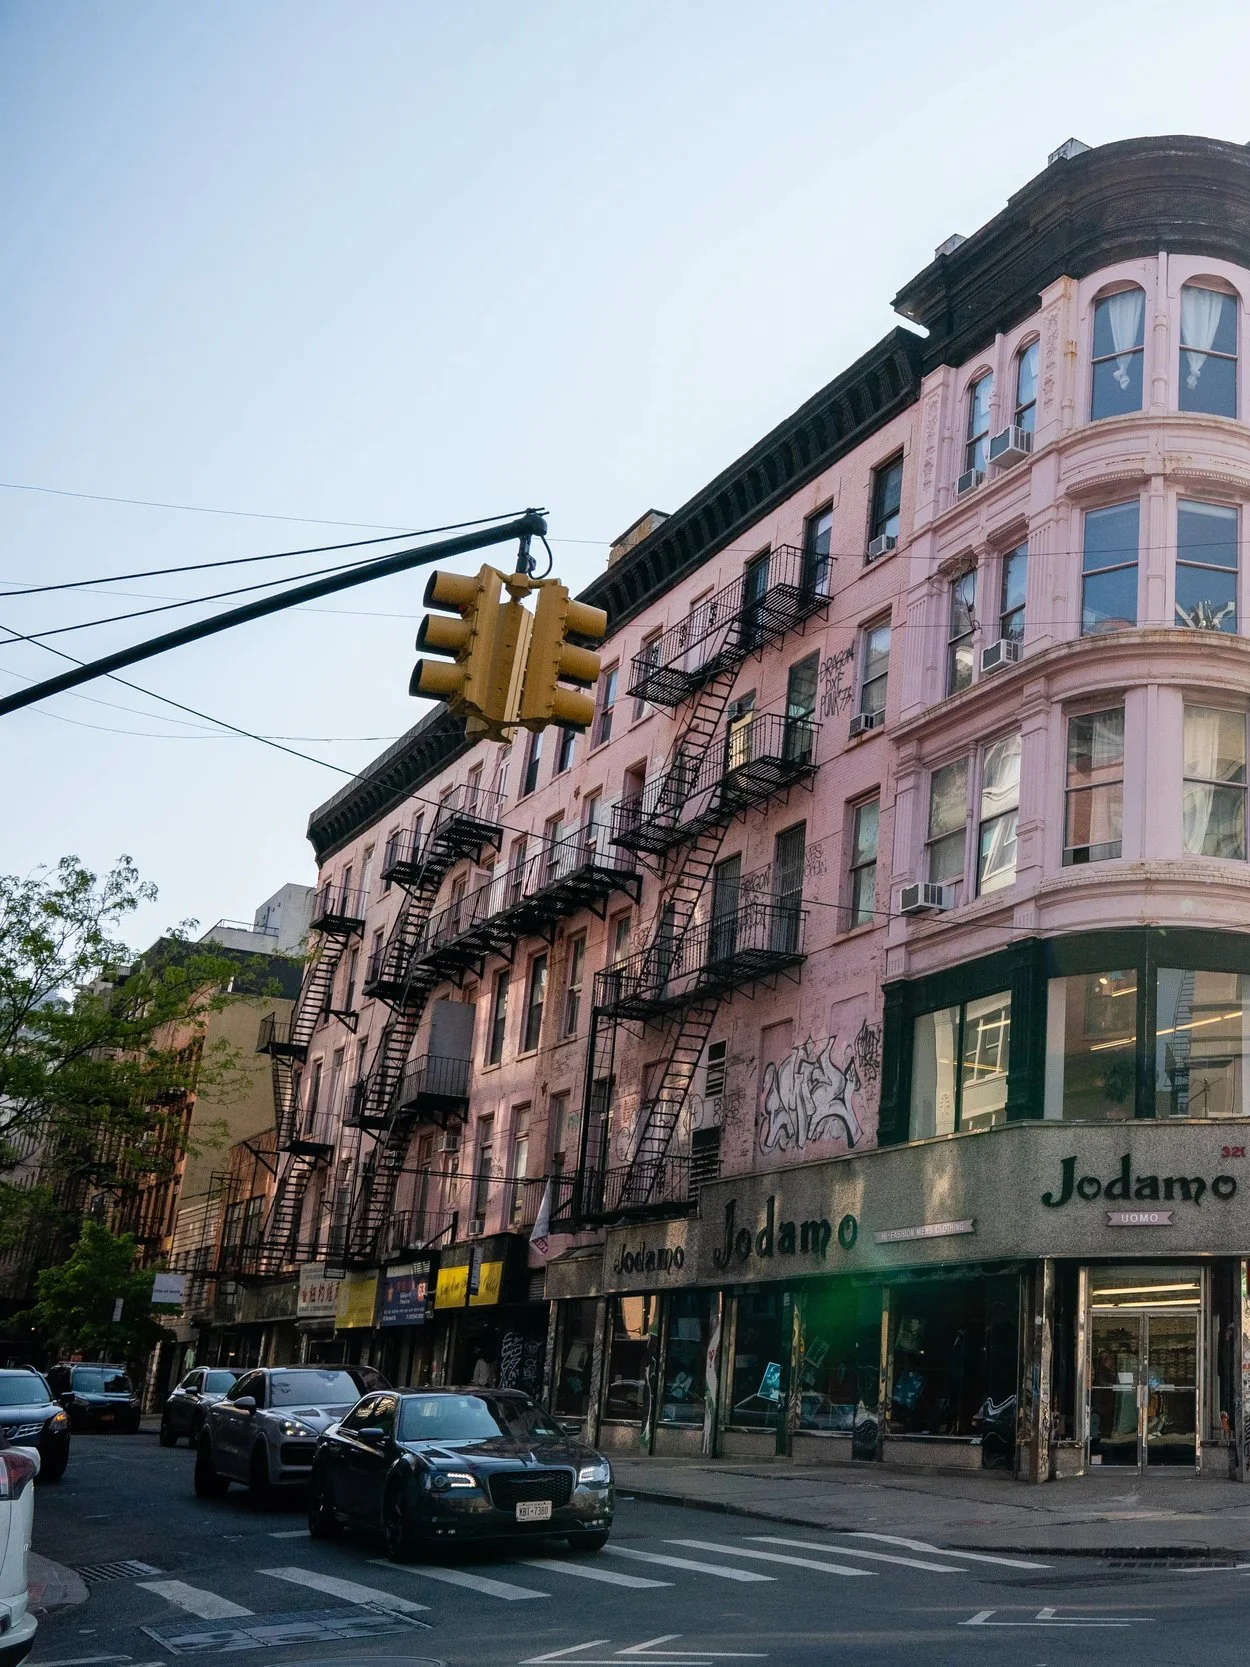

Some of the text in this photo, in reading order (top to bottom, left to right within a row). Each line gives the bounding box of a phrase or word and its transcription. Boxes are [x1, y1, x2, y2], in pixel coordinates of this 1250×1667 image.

[1041, 1153, 1238, 1208] Jodamo
[713, 1195, 858, 1270] Jodamo
[916, 1226, 933, 1236] MENS
[935, 1222, 964, 1234] CLOTHING
[1121, 1213, 1159, 1223] UOMO
[613, 1241, 685, 1275] Jodamo
